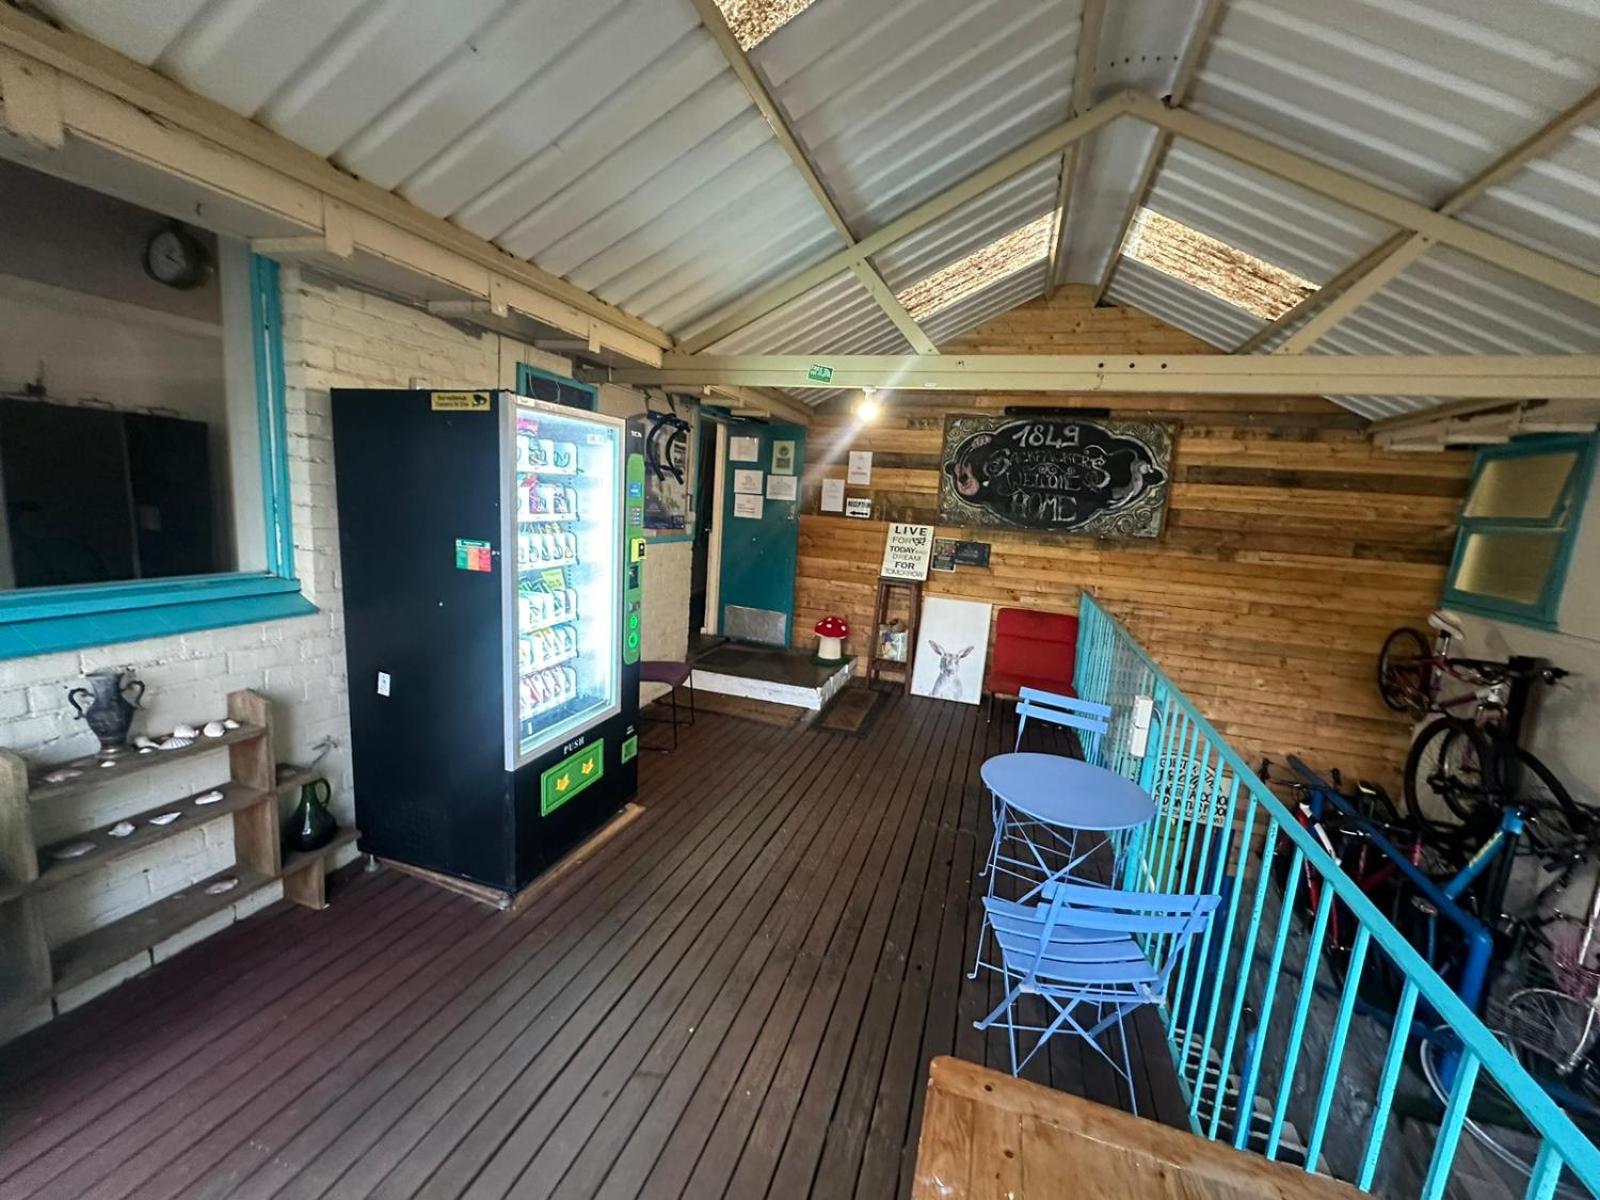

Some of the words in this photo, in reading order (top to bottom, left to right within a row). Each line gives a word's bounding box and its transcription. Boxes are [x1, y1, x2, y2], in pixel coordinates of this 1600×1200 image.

[1012, 424, 1080, 448] 1849
[895, 526, 927, 536] LIVE
[893, 536, 911, 544] FOR
[895, 561, 915, 569] FOR
[564, 737, 585, 754] PUSH
